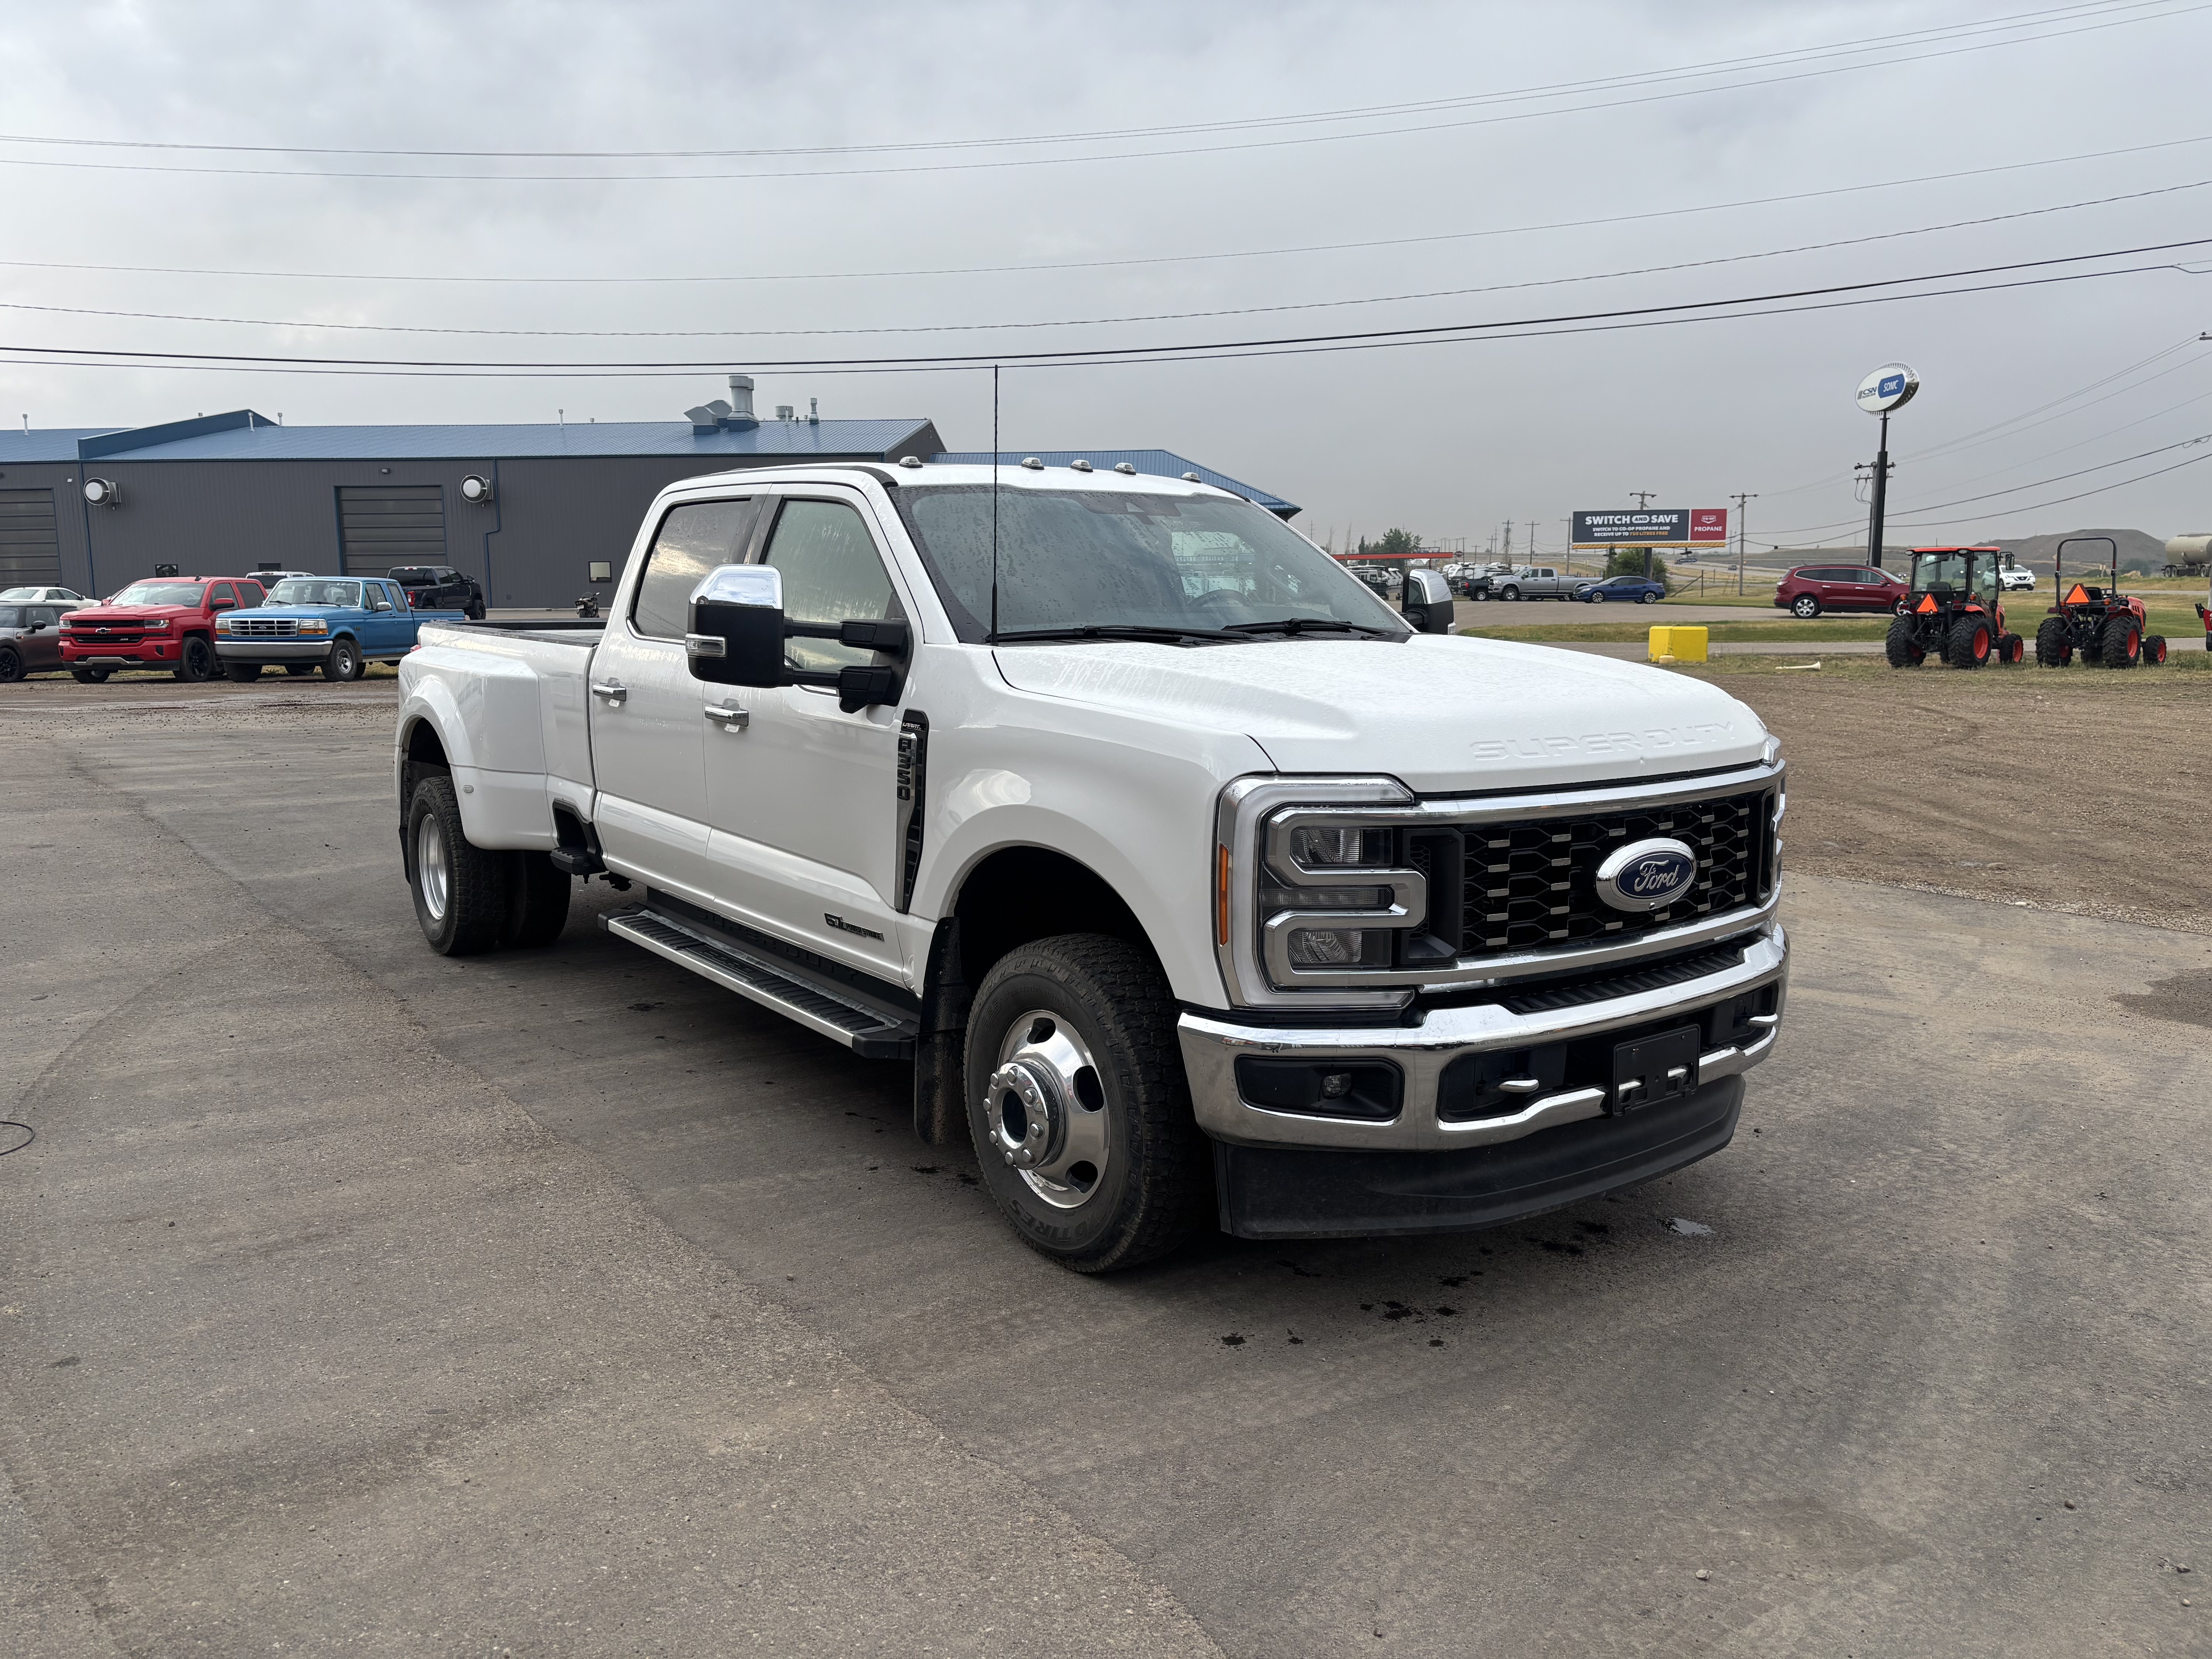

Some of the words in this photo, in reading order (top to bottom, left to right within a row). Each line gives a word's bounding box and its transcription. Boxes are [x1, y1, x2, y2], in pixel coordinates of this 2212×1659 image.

[1863, 386, 1877, 395] CSN
[1883, 380, 1899, 392] SONIC
[1585, 515, 1630, 525] SWITCH
[1651, 515, 1678, 523] SAVE
[1469, 732, 1643, 761] SUPER
[1644, 721, 1734, 748] DUTY
[1634, 859, 1680, 892] Ford
[696, 908, 776, 949] SUPER
[784, 945, 859, 981] DUTY
[1008, 1199, 1072, 1242] TIRES
